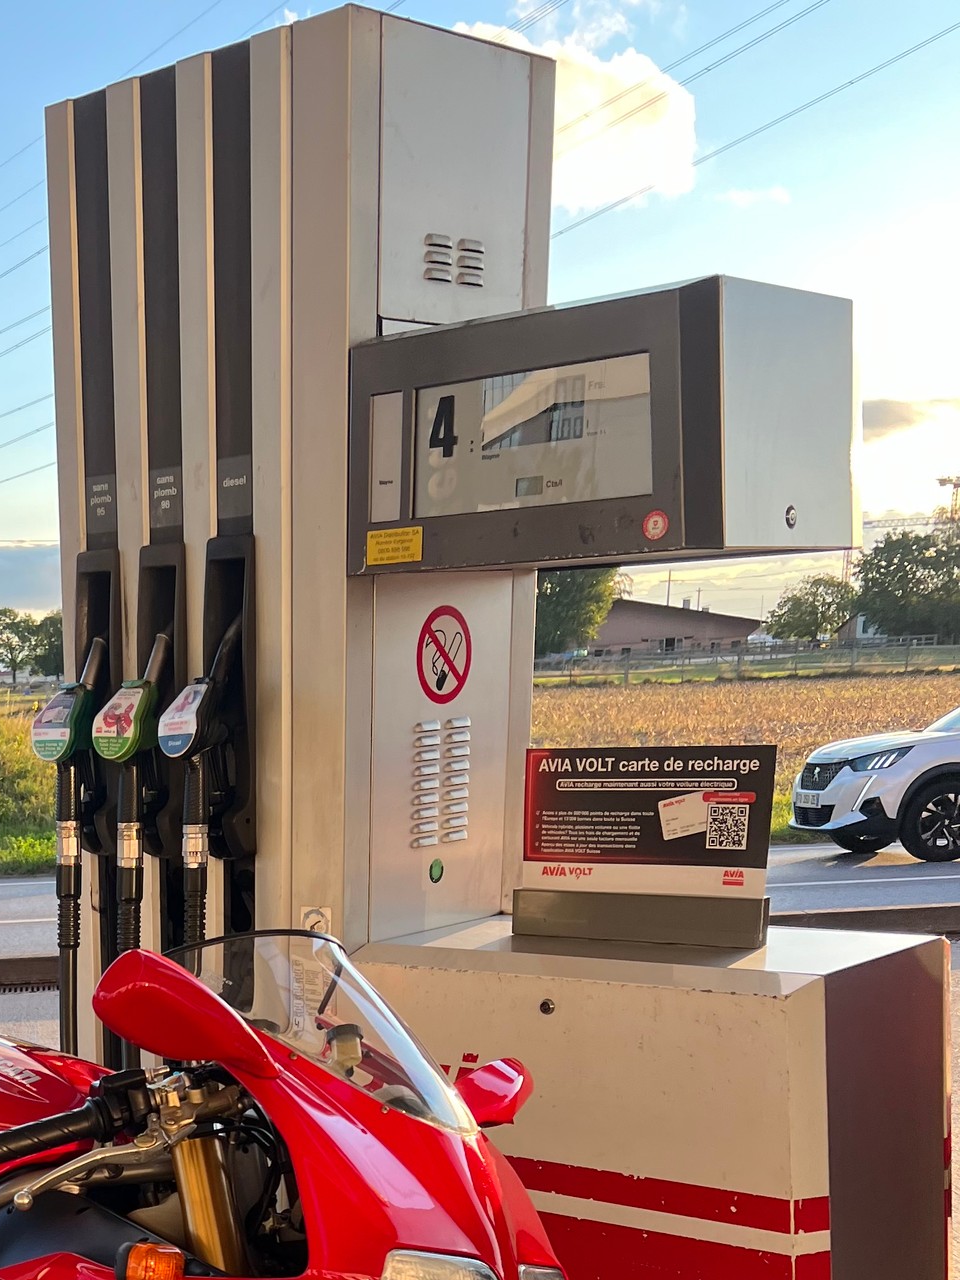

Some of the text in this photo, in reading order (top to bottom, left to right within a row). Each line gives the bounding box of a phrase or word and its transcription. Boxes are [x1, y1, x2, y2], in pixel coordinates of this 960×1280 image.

[429, 395, 458, 458] 4
[157, 475, 174, 485] sans
[223, 475, 246, 487] diesel
[93, 482, 108, 491] sans
[154, 486, 177, 499] plomb
[90, 494, 112, 506] plomb
[96, 507, 105, 516] 95
[539, 756, 759, 774] AVIA VOLT carte de recharge
[575, 781, 602, 789] recharge
[542, 865, 593, 878] AVIA VOLT
[723, 869, 744, 878] AVIA
